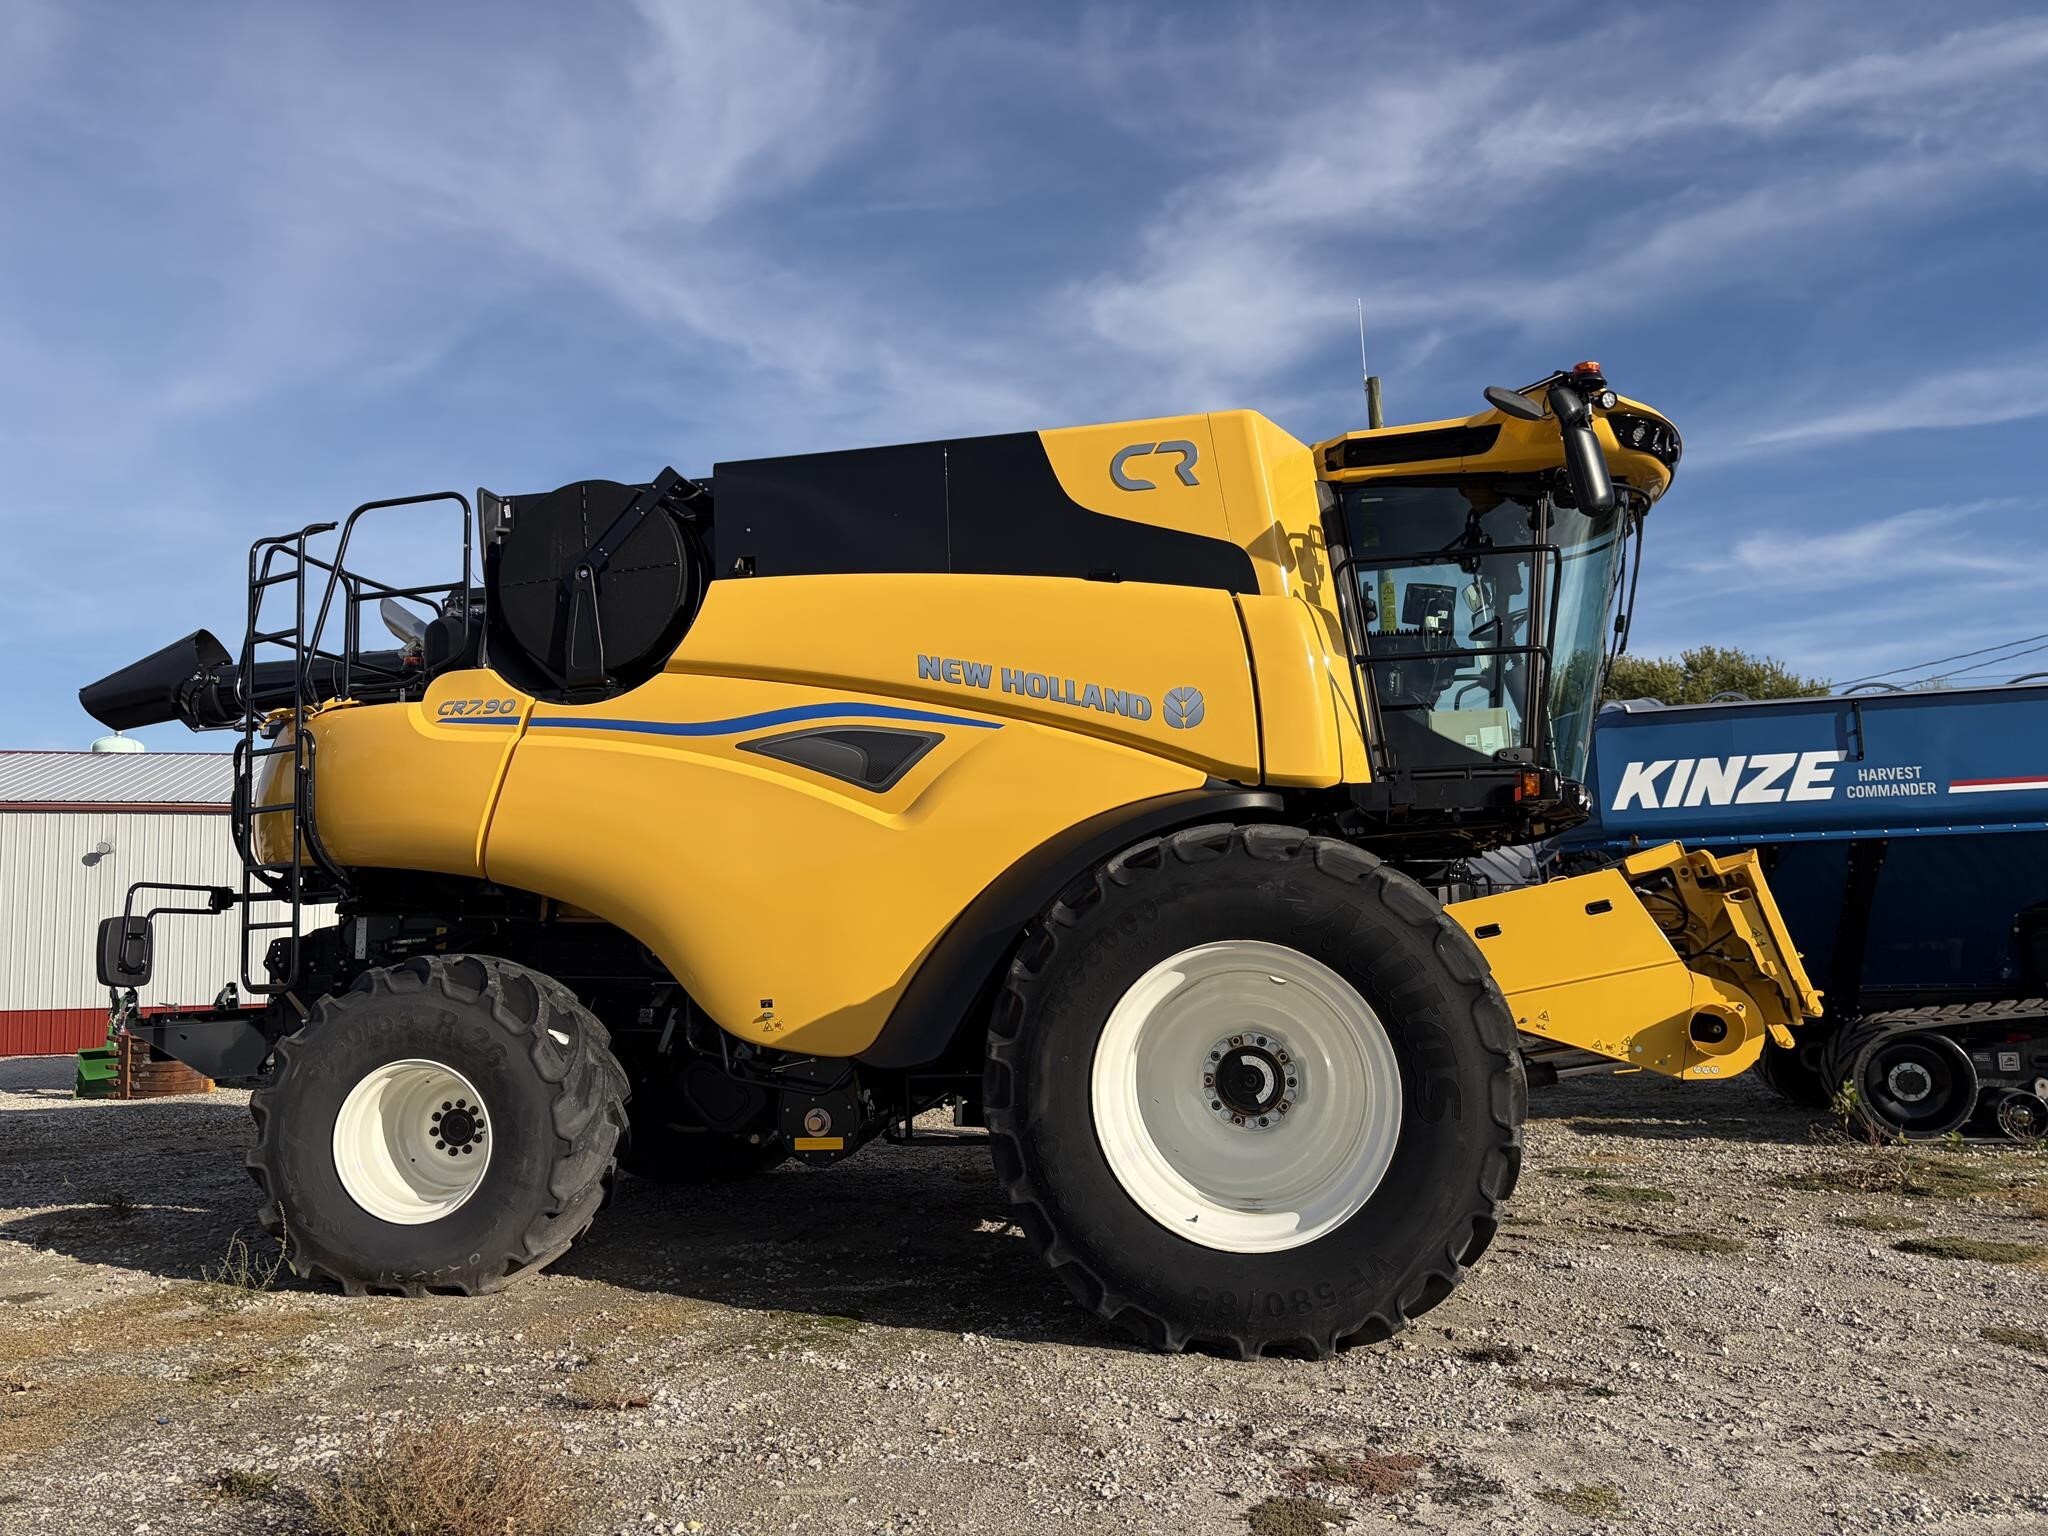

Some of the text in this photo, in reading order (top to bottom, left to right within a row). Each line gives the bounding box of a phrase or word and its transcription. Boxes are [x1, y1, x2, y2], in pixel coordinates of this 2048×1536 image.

[1109, 440, 1200, 492] CR
[917, 654, 1152, 721] NEW HOLLAND
[437, 699, 516, 715] CR7.90
[1612, 750, 1848, 811] KINZE
[1846, 782, 1938, 799] COMMANDER
[1858, 766, 1922, 781] HARVEST
